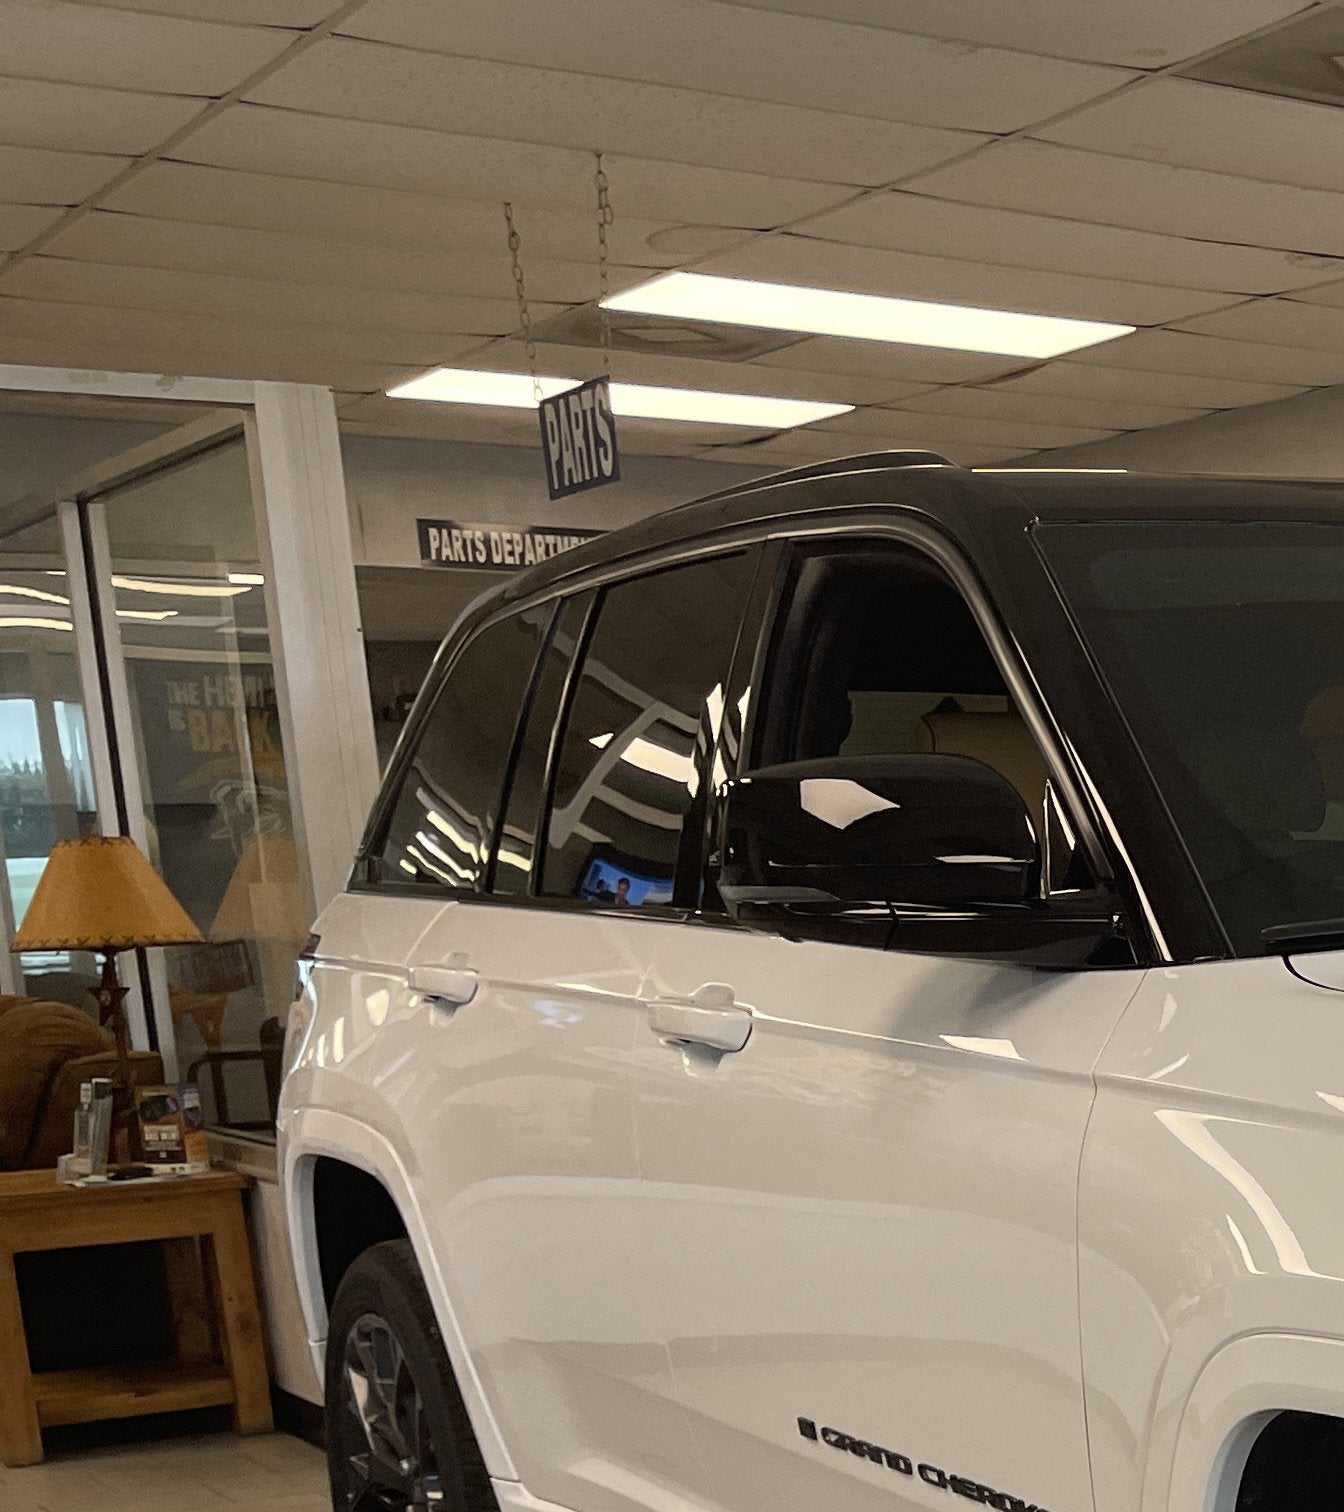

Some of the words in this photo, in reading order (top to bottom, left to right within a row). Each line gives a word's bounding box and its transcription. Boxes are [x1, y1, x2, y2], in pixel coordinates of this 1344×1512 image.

[545, 383, 615, 490] PARTS
[428, 527, 488, 563] PARTS
[490, 530, 594, 566] DEPART
[820, 1426, 913, 1476] GRAND
